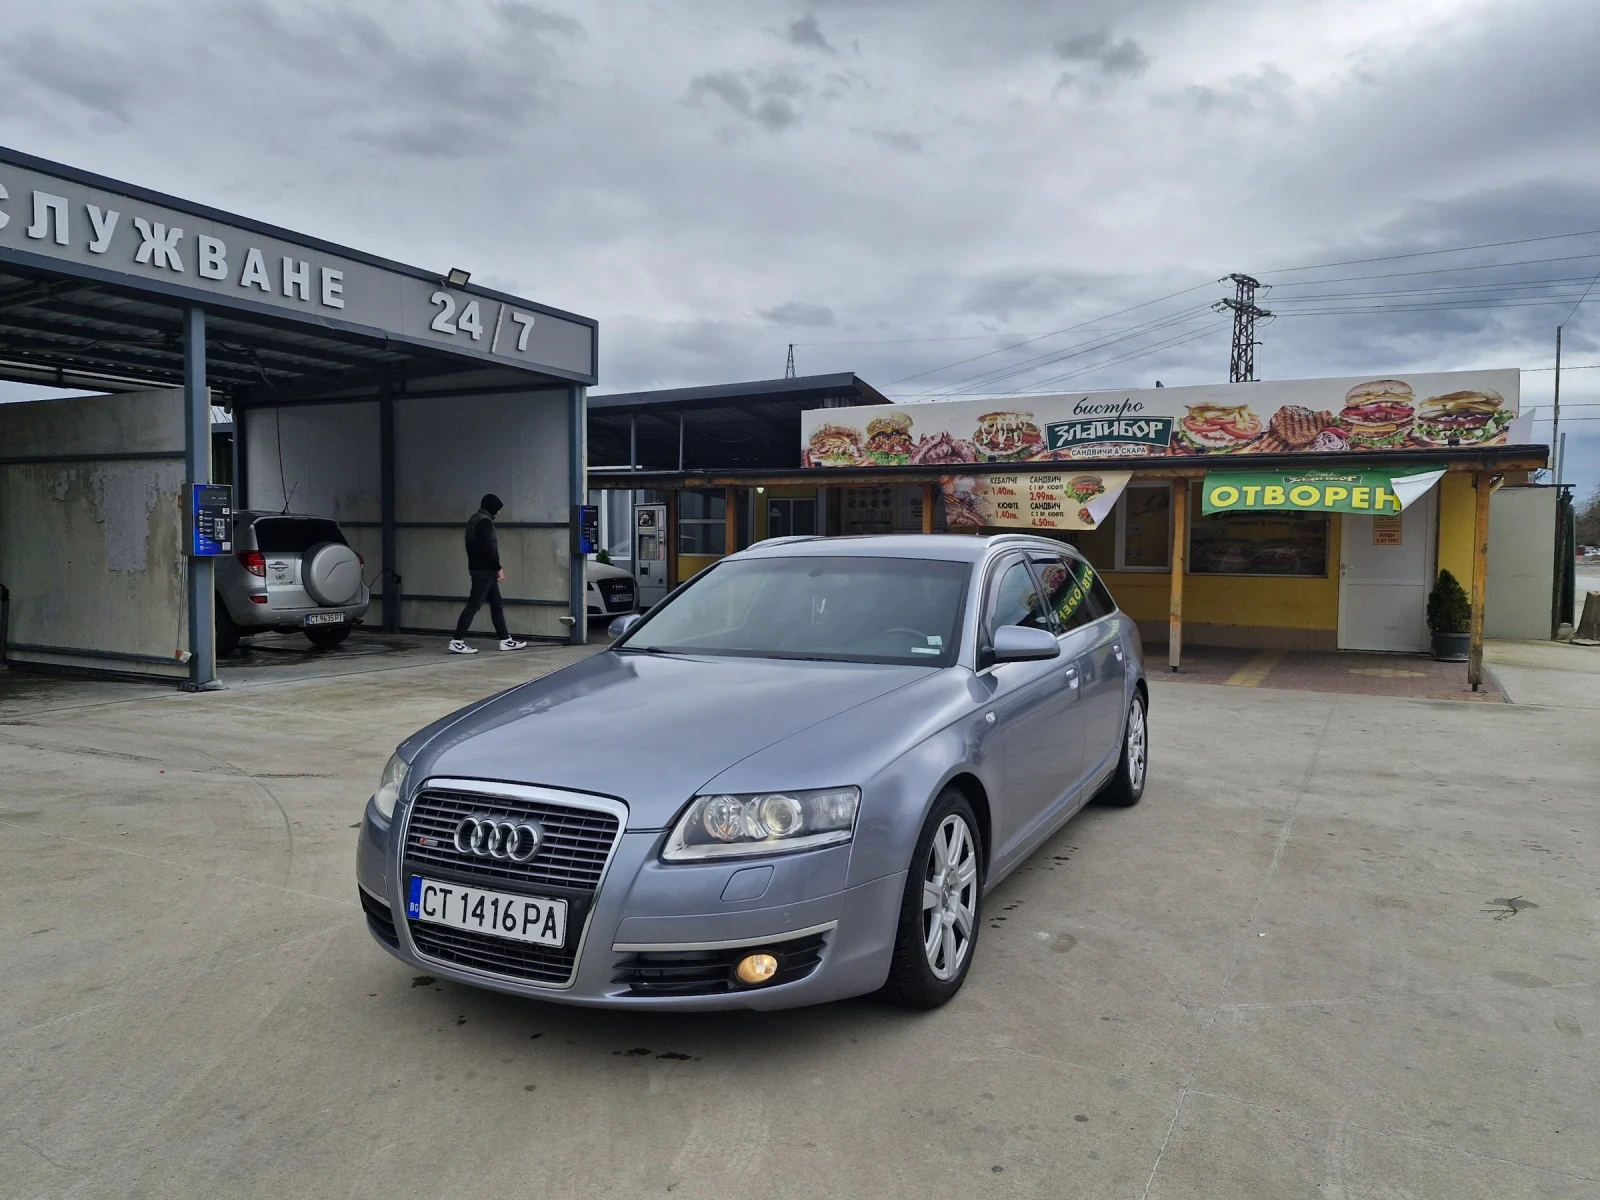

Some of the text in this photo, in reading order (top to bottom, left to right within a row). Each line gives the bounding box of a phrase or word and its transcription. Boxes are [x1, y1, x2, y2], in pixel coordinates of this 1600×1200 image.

[0, 181, 535, 353] ЛУЖВАНЕ 24/7
[1072, 396, 1144, 419] бистро
[1071, 448, 1112, 457] САНДВИЧИ
[1121, 447, 1146, 455] СКАРА
[989, 477, 1018, 485] КЕБАПЧЕ
[1029, 476, 1062, 484] САНДВИЧ
[1210, 485, 1402, 511] ОТВОРЕН
[997, 502, 1019, 510] КЮФТЕ
[1030, 502, 1061, 510] САНДВИЧ
[409, 902, 419, 913] BG
[423, 885, 557, 940] CT 1416 PA
